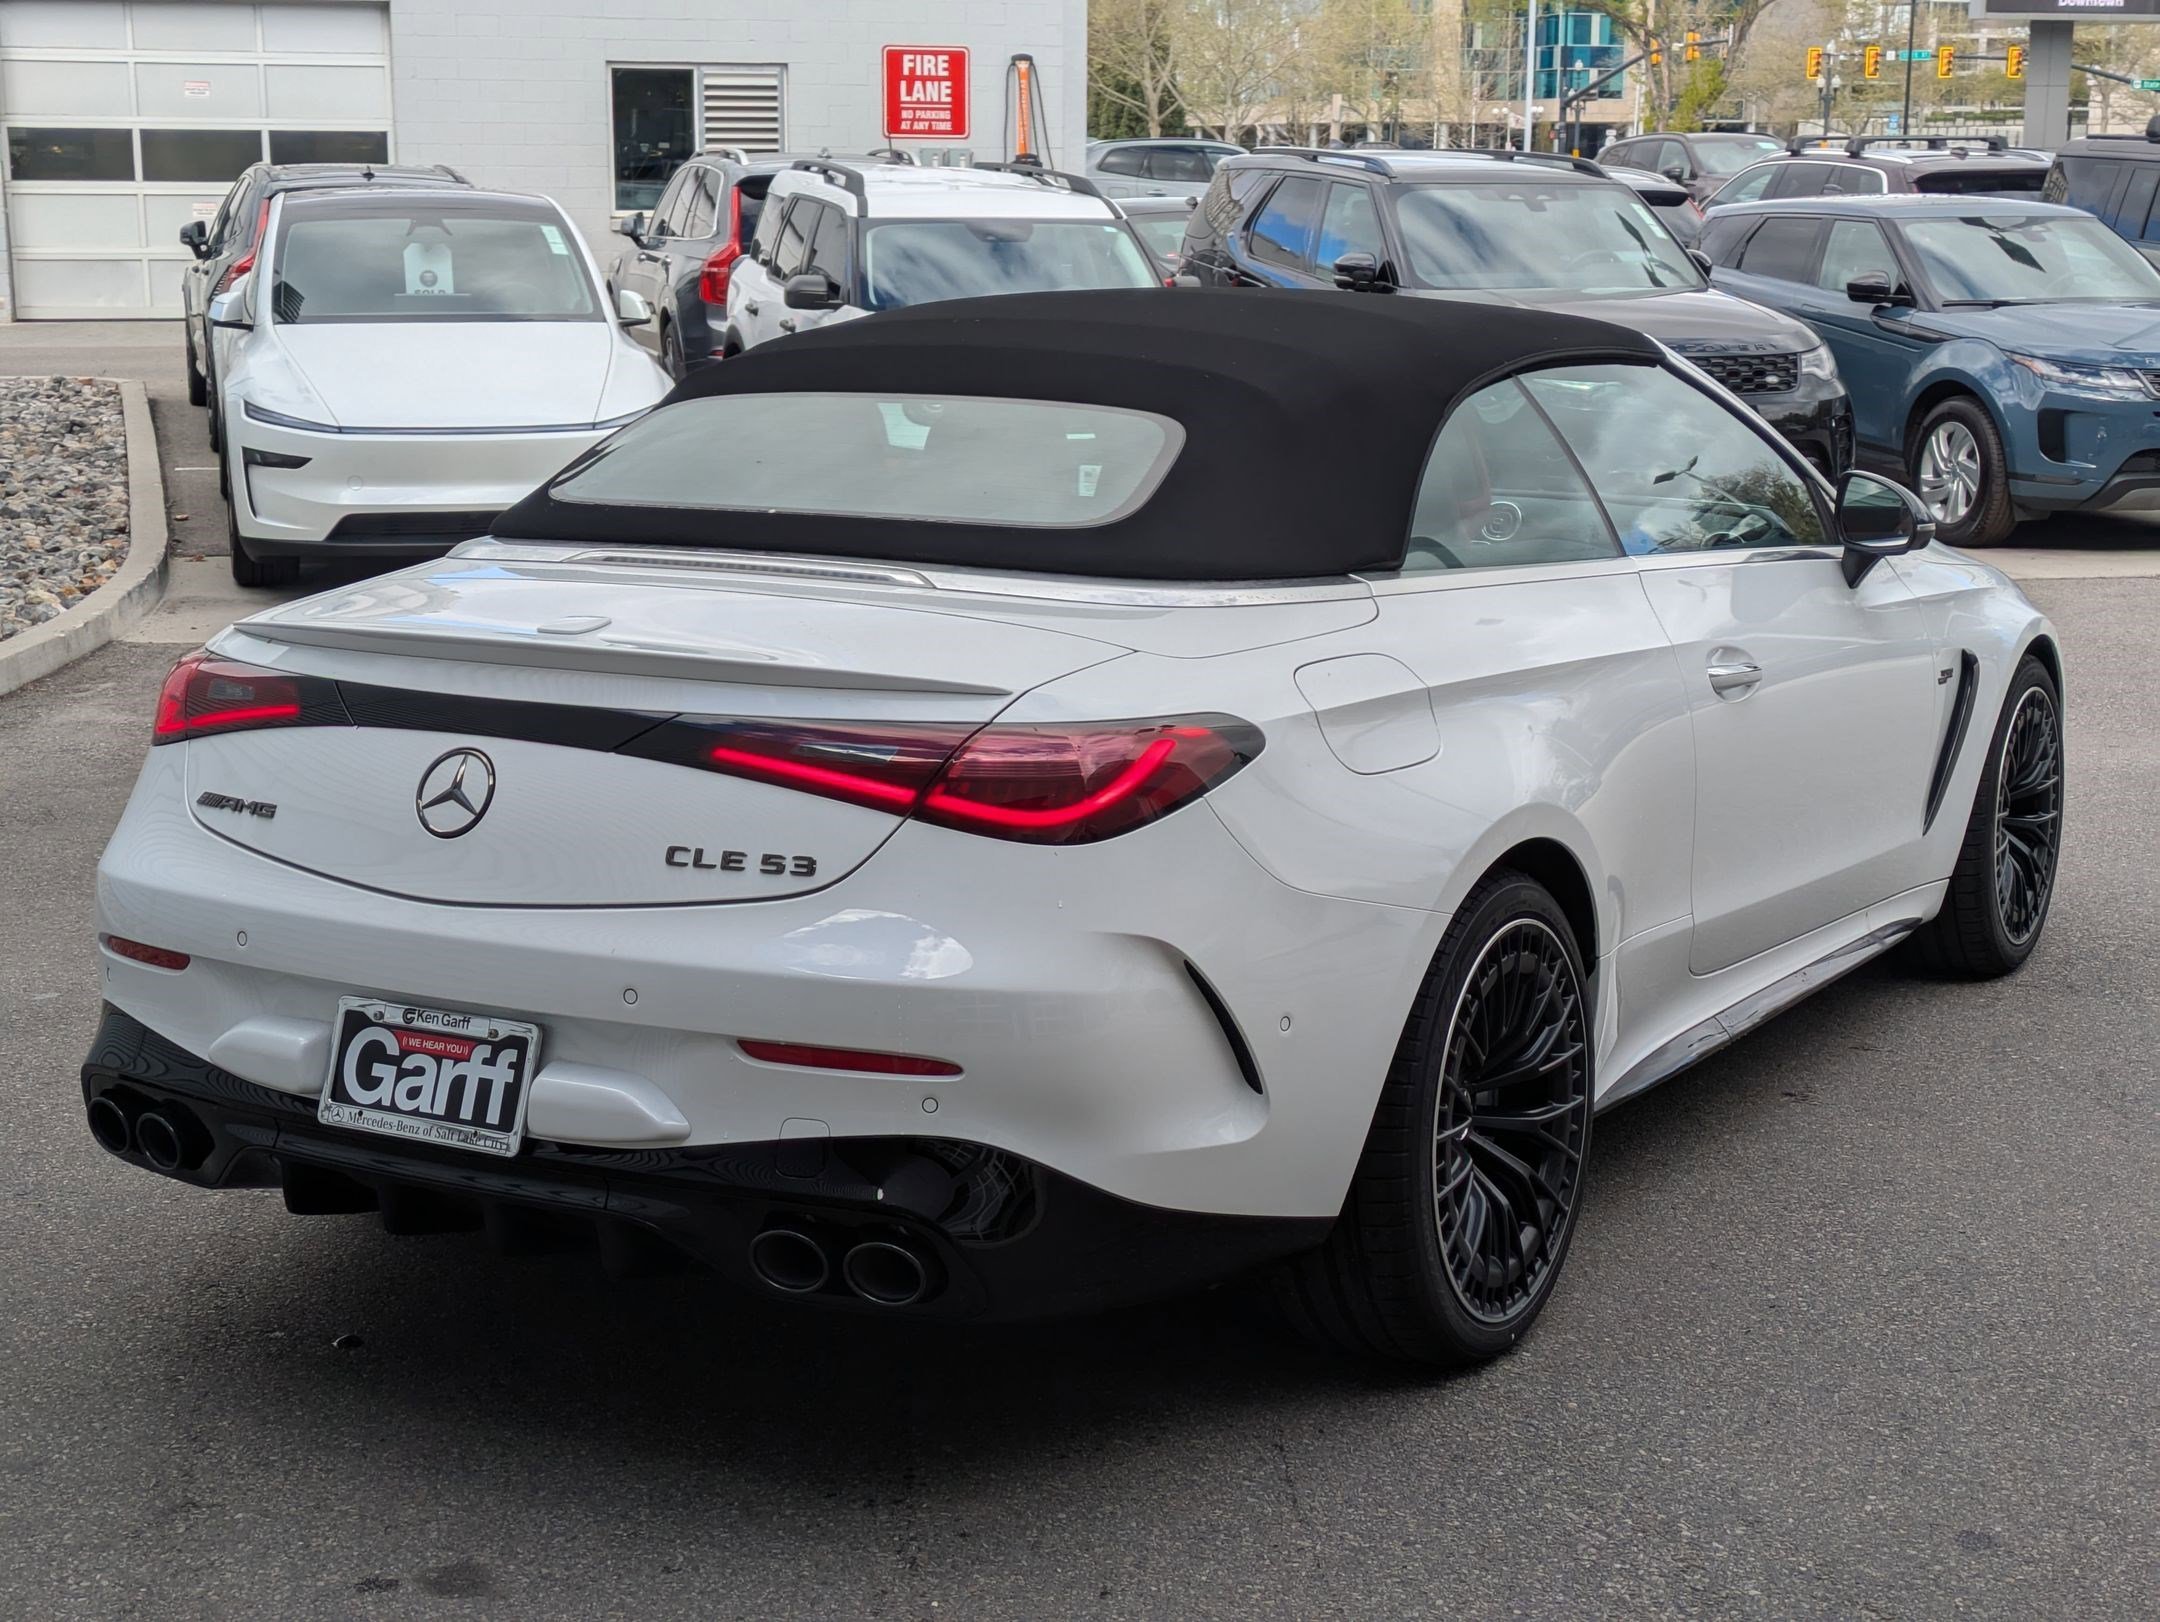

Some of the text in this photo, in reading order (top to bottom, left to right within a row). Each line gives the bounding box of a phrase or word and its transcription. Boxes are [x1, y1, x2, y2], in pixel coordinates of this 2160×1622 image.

[902, 54, 949, 76] FIRE
[900, 80, 952, 102] LANE
[900, 121, 952, 131] AT ANY TIME
[901, 110, 951, 120] NO PARKING
[213, 794, 277, 819] AMG
[665, 846, 817, 877] CLE 53
[416, 1009, 472, 1030] Ken Garff
[409, 1037, 463, 1054] WE HEAR YOU
[343, 1026, 518, 1125] Garff
[347, 1111, 420, 1136] Mercedes-Benz
[422, 1126, 433, 1137] of
[434, 1127, 455, 1141] Salt
[457, 1130, 481, 1146] Lake
